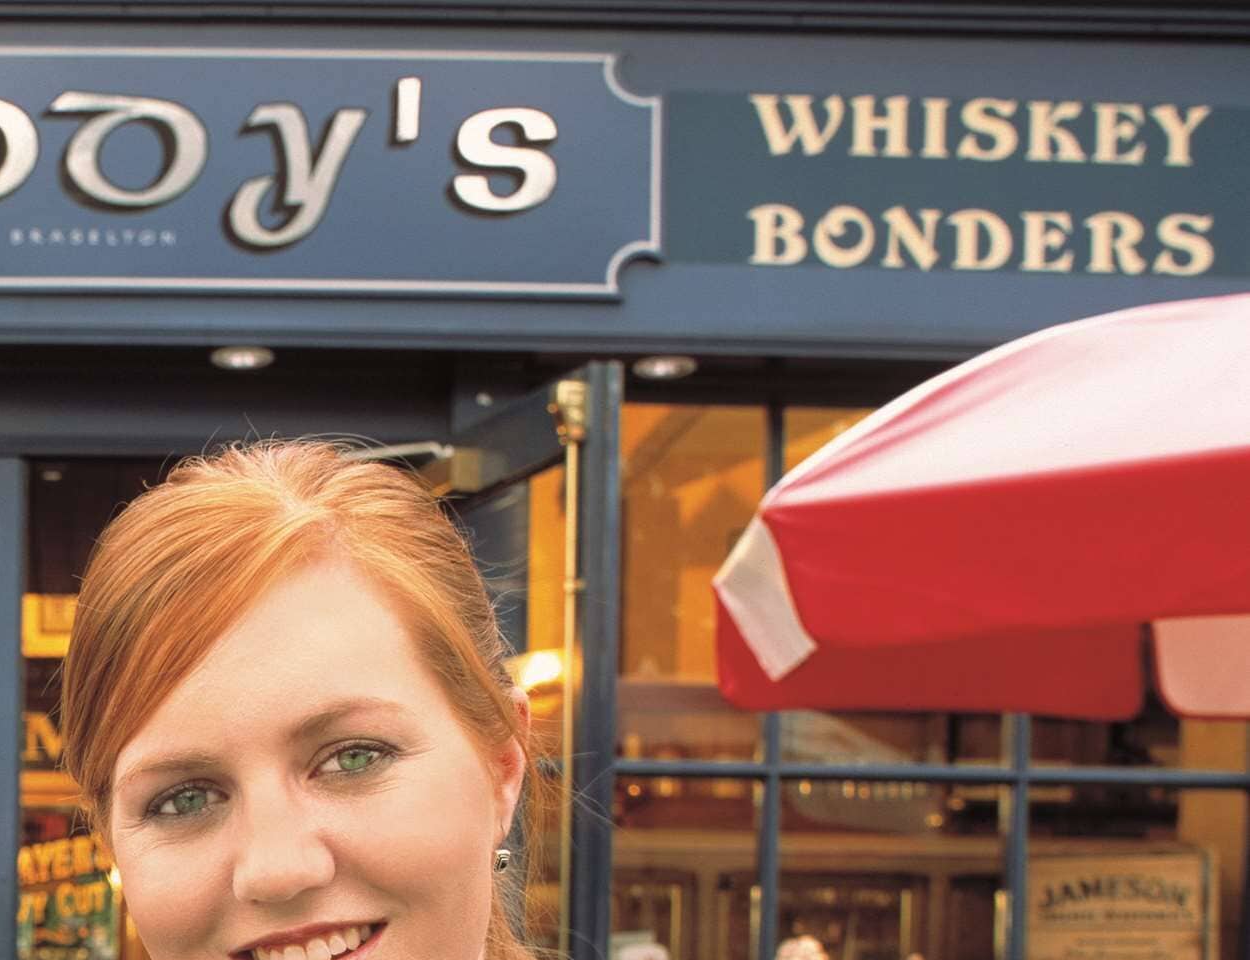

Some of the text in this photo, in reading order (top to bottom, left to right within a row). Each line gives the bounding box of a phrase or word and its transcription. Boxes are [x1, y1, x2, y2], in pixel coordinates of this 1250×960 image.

[750, 93, 1211, 167] WHISKEY
[747, 203, 1214, 276] BONDERS
[1038, 875, 1191, 909] JAMESON
